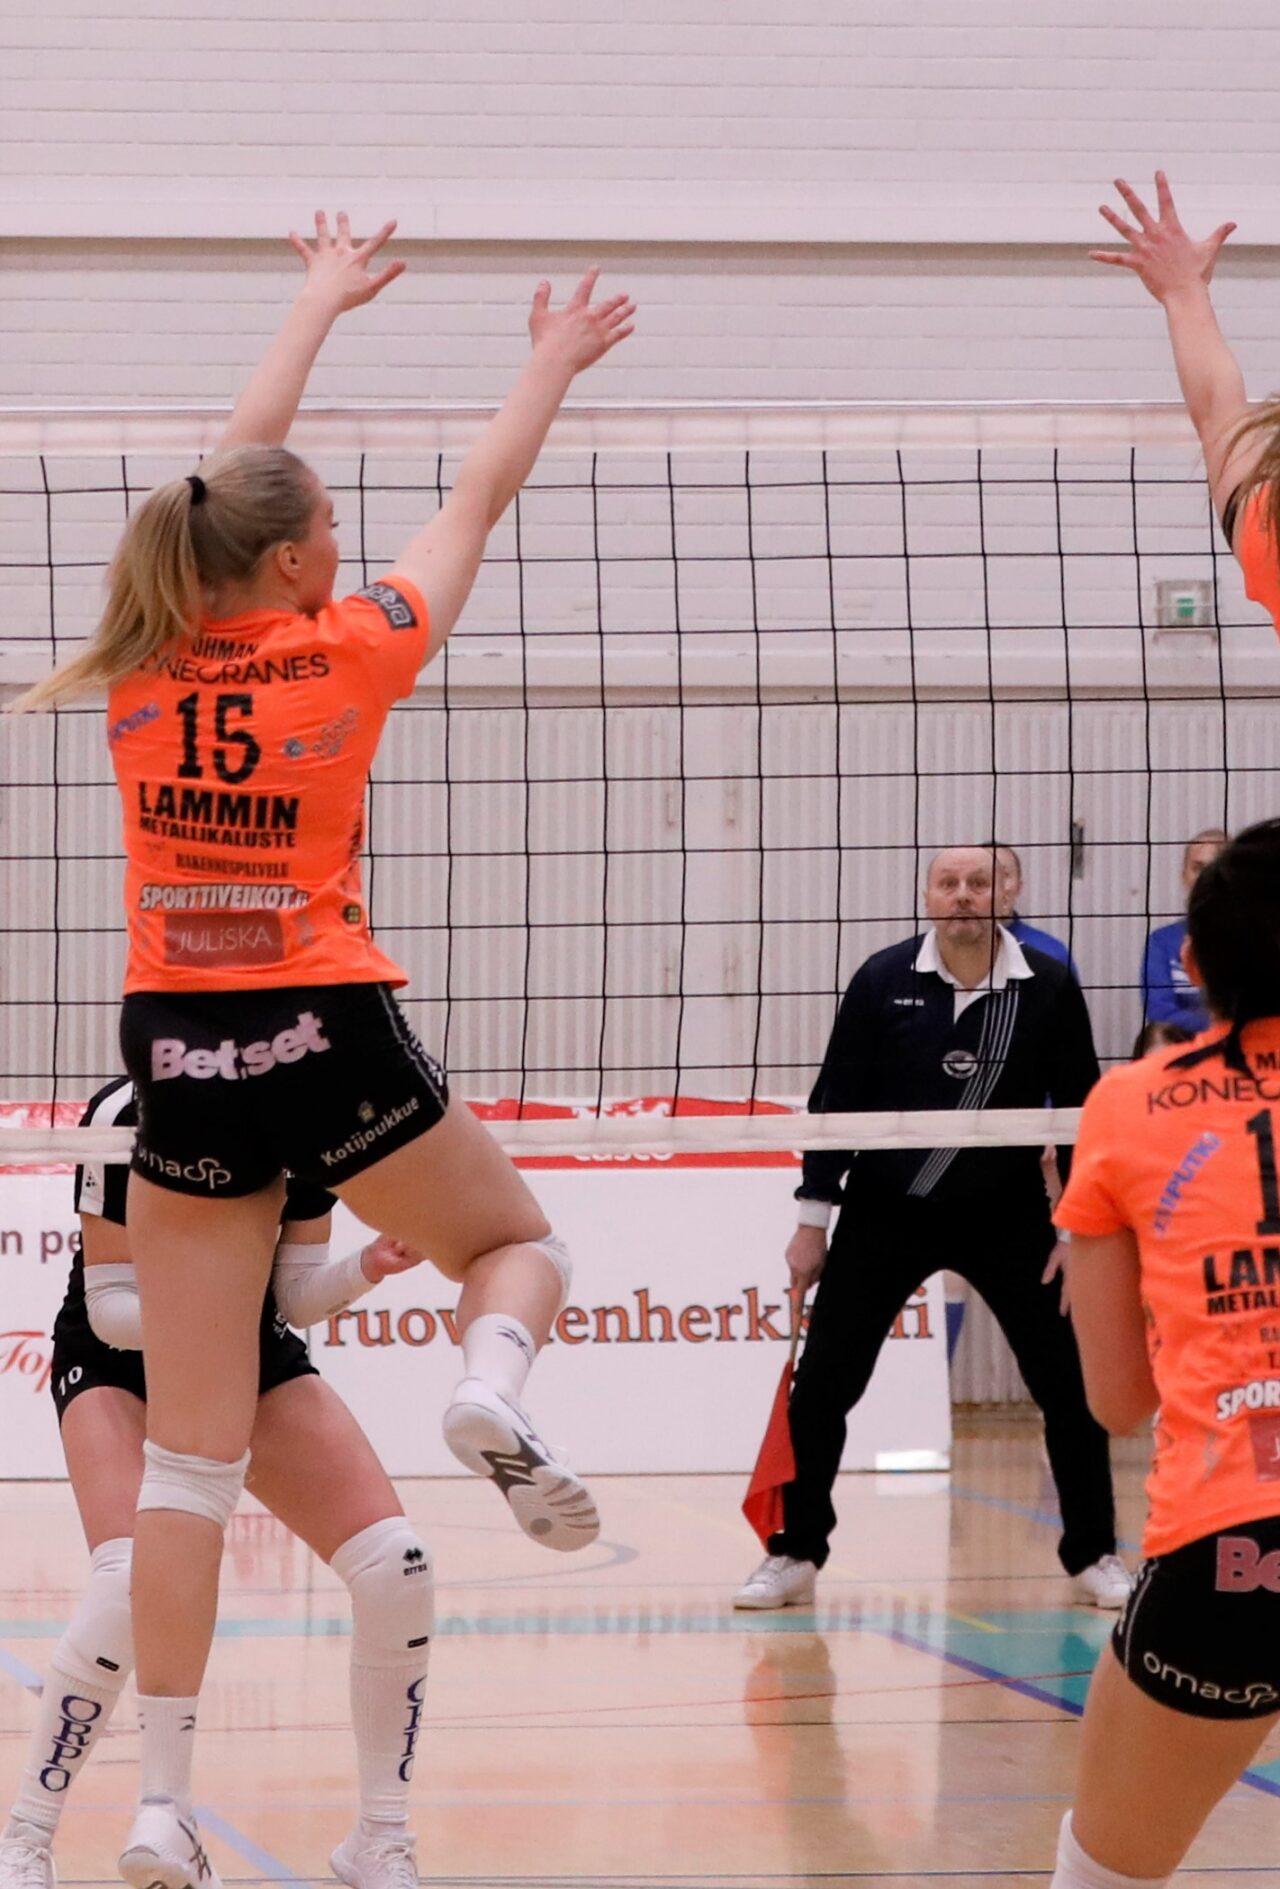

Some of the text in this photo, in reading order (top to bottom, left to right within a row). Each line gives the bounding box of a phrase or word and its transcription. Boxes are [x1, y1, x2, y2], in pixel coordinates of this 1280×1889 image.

[176, 691, 262, 785] 15
[138, 781, 300, 829] LAMMIN
[140, 815, 297, 849] METALLIKALUSTE
[151, 1010, 331, 1082] Betset
[320, 1097, 420, 1168] Kotijoukkue
[58, 1365, 84, 1397] 10
[39, 1694, 102, 1793] ORPO
